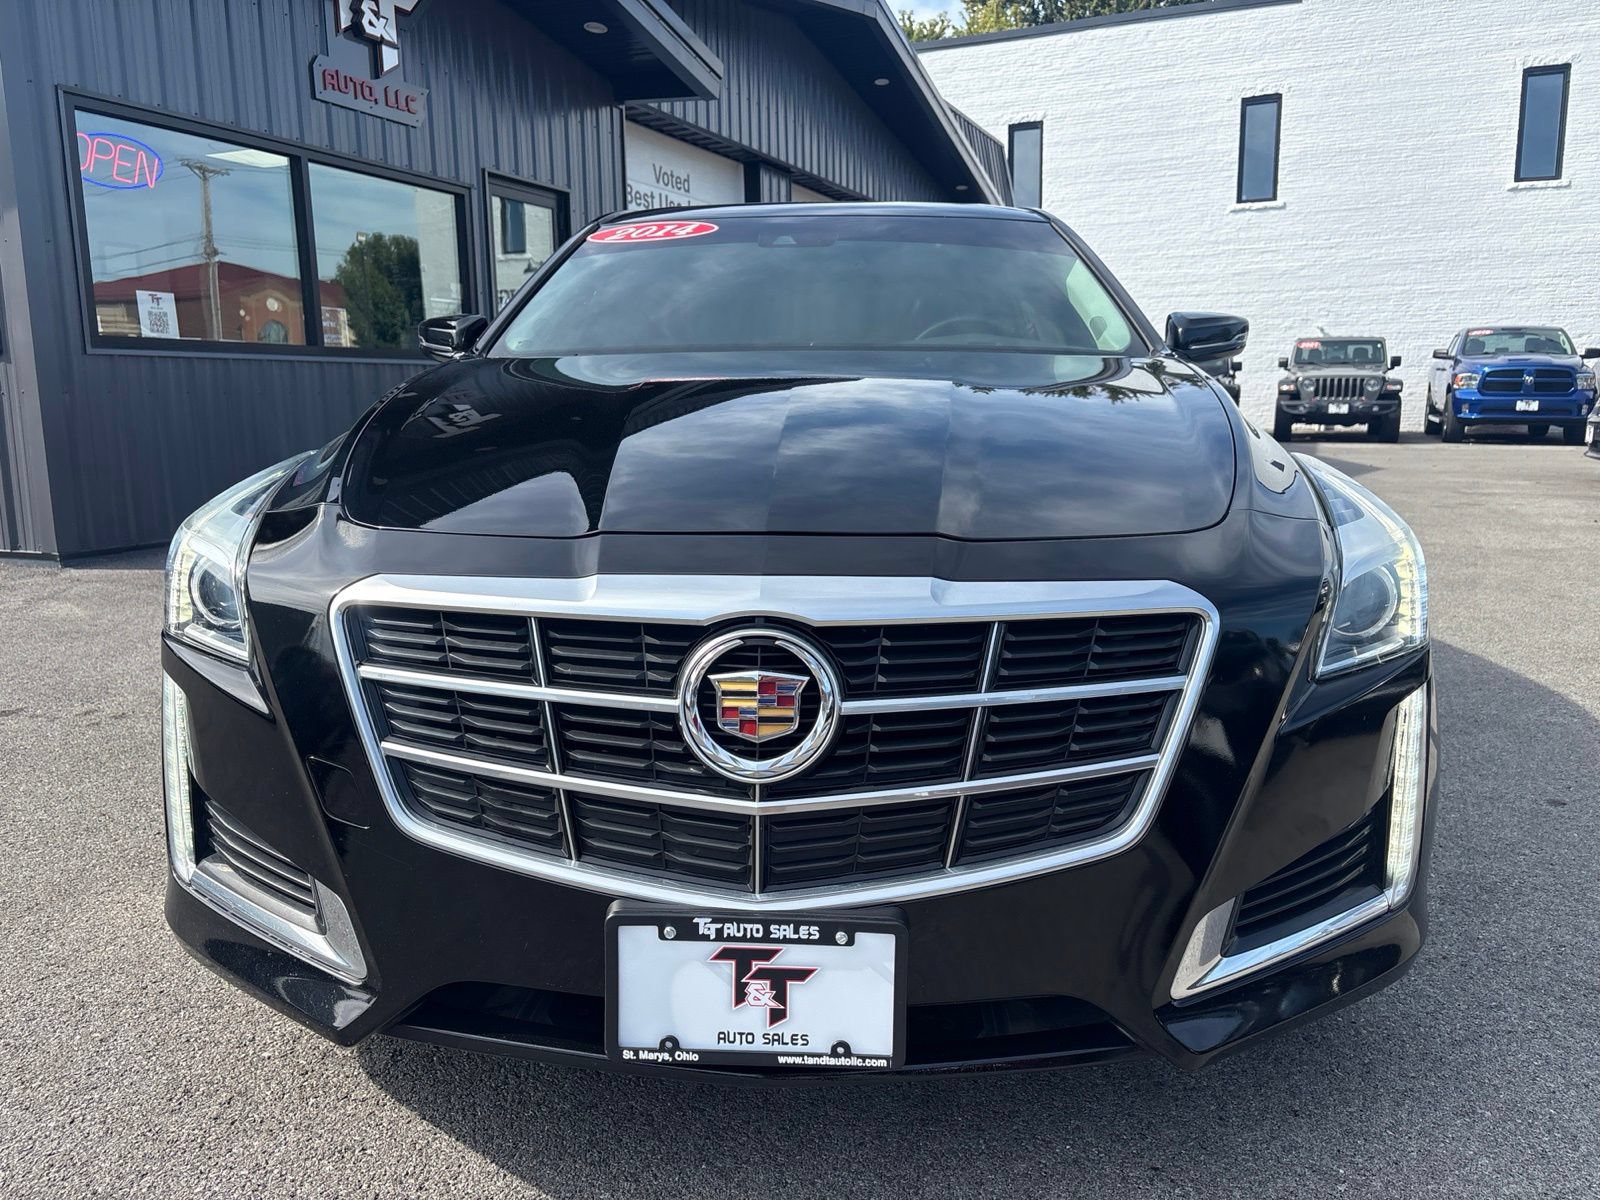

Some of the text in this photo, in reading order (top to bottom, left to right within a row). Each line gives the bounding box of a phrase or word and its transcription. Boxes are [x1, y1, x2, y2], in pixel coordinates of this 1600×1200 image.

[322, 69, 417, 115] AUTO, LLC
[652, 163, 690, 193] Voted
[626, 183, 656, 209] Best
[604, 223, 701, 240] 2014
[723, 921, 763, 939] AUTO
[769, 923, 820, 940] SALES
[707, 944, 820, 1030] T&T
[717, 1030, 809, 1047] AUTO SALES
[622, 1049, 699, 1062] St. Marys, Ohio
[777, 1055, 888, 1067] www.tandtautollc.com
